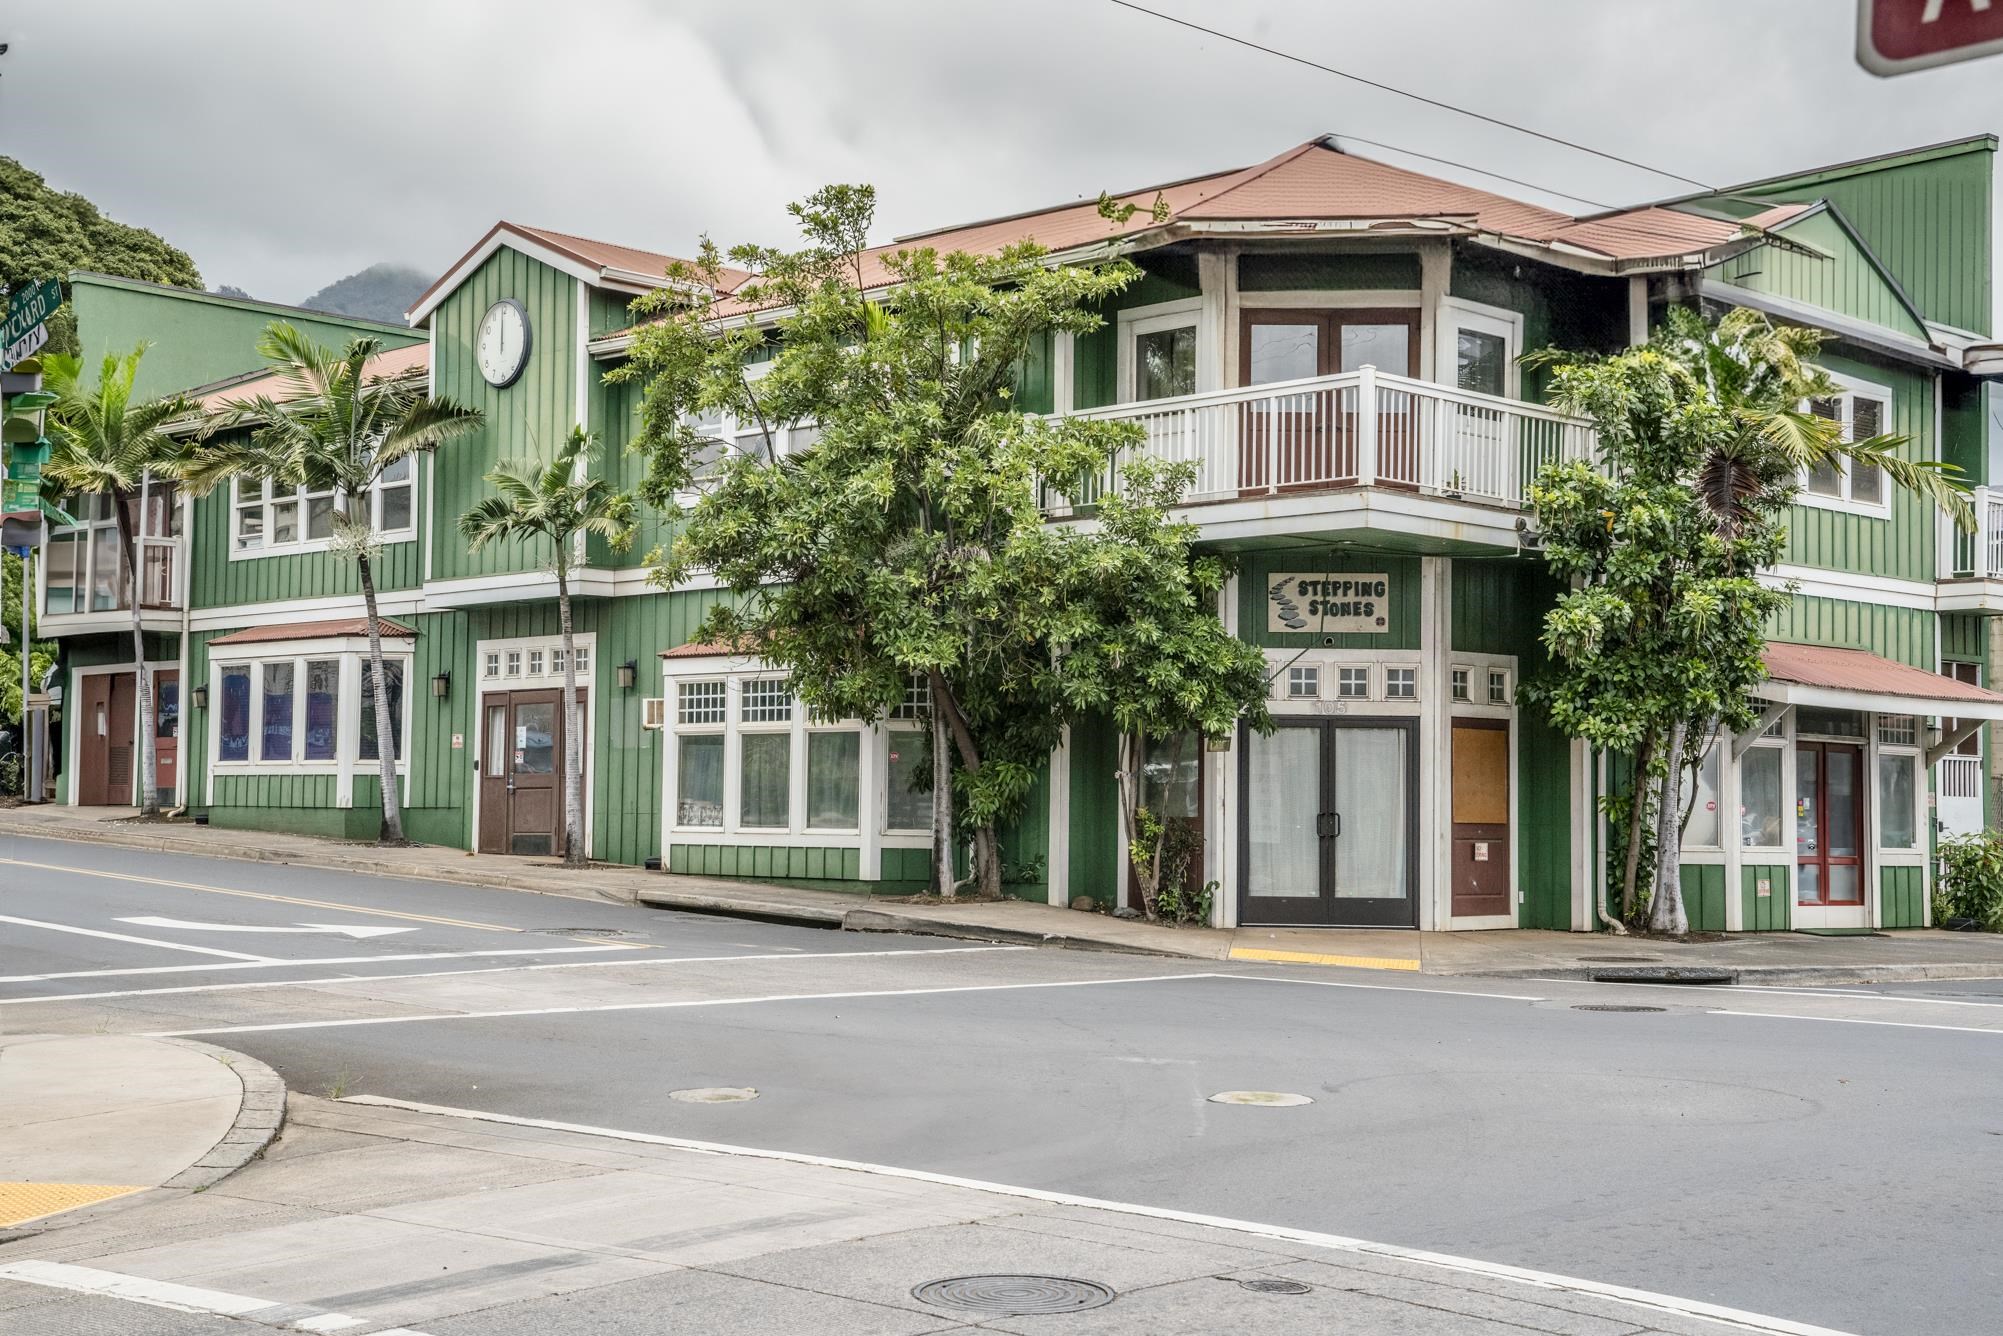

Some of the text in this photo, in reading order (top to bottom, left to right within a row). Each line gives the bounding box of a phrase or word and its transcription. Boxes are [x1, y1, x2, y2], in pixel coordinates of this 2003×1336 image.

[51, 285, 59, 299] ST
[1298, 580, 1386, 598] STEPPING
[1308, 600, 1375, 617] STONES
